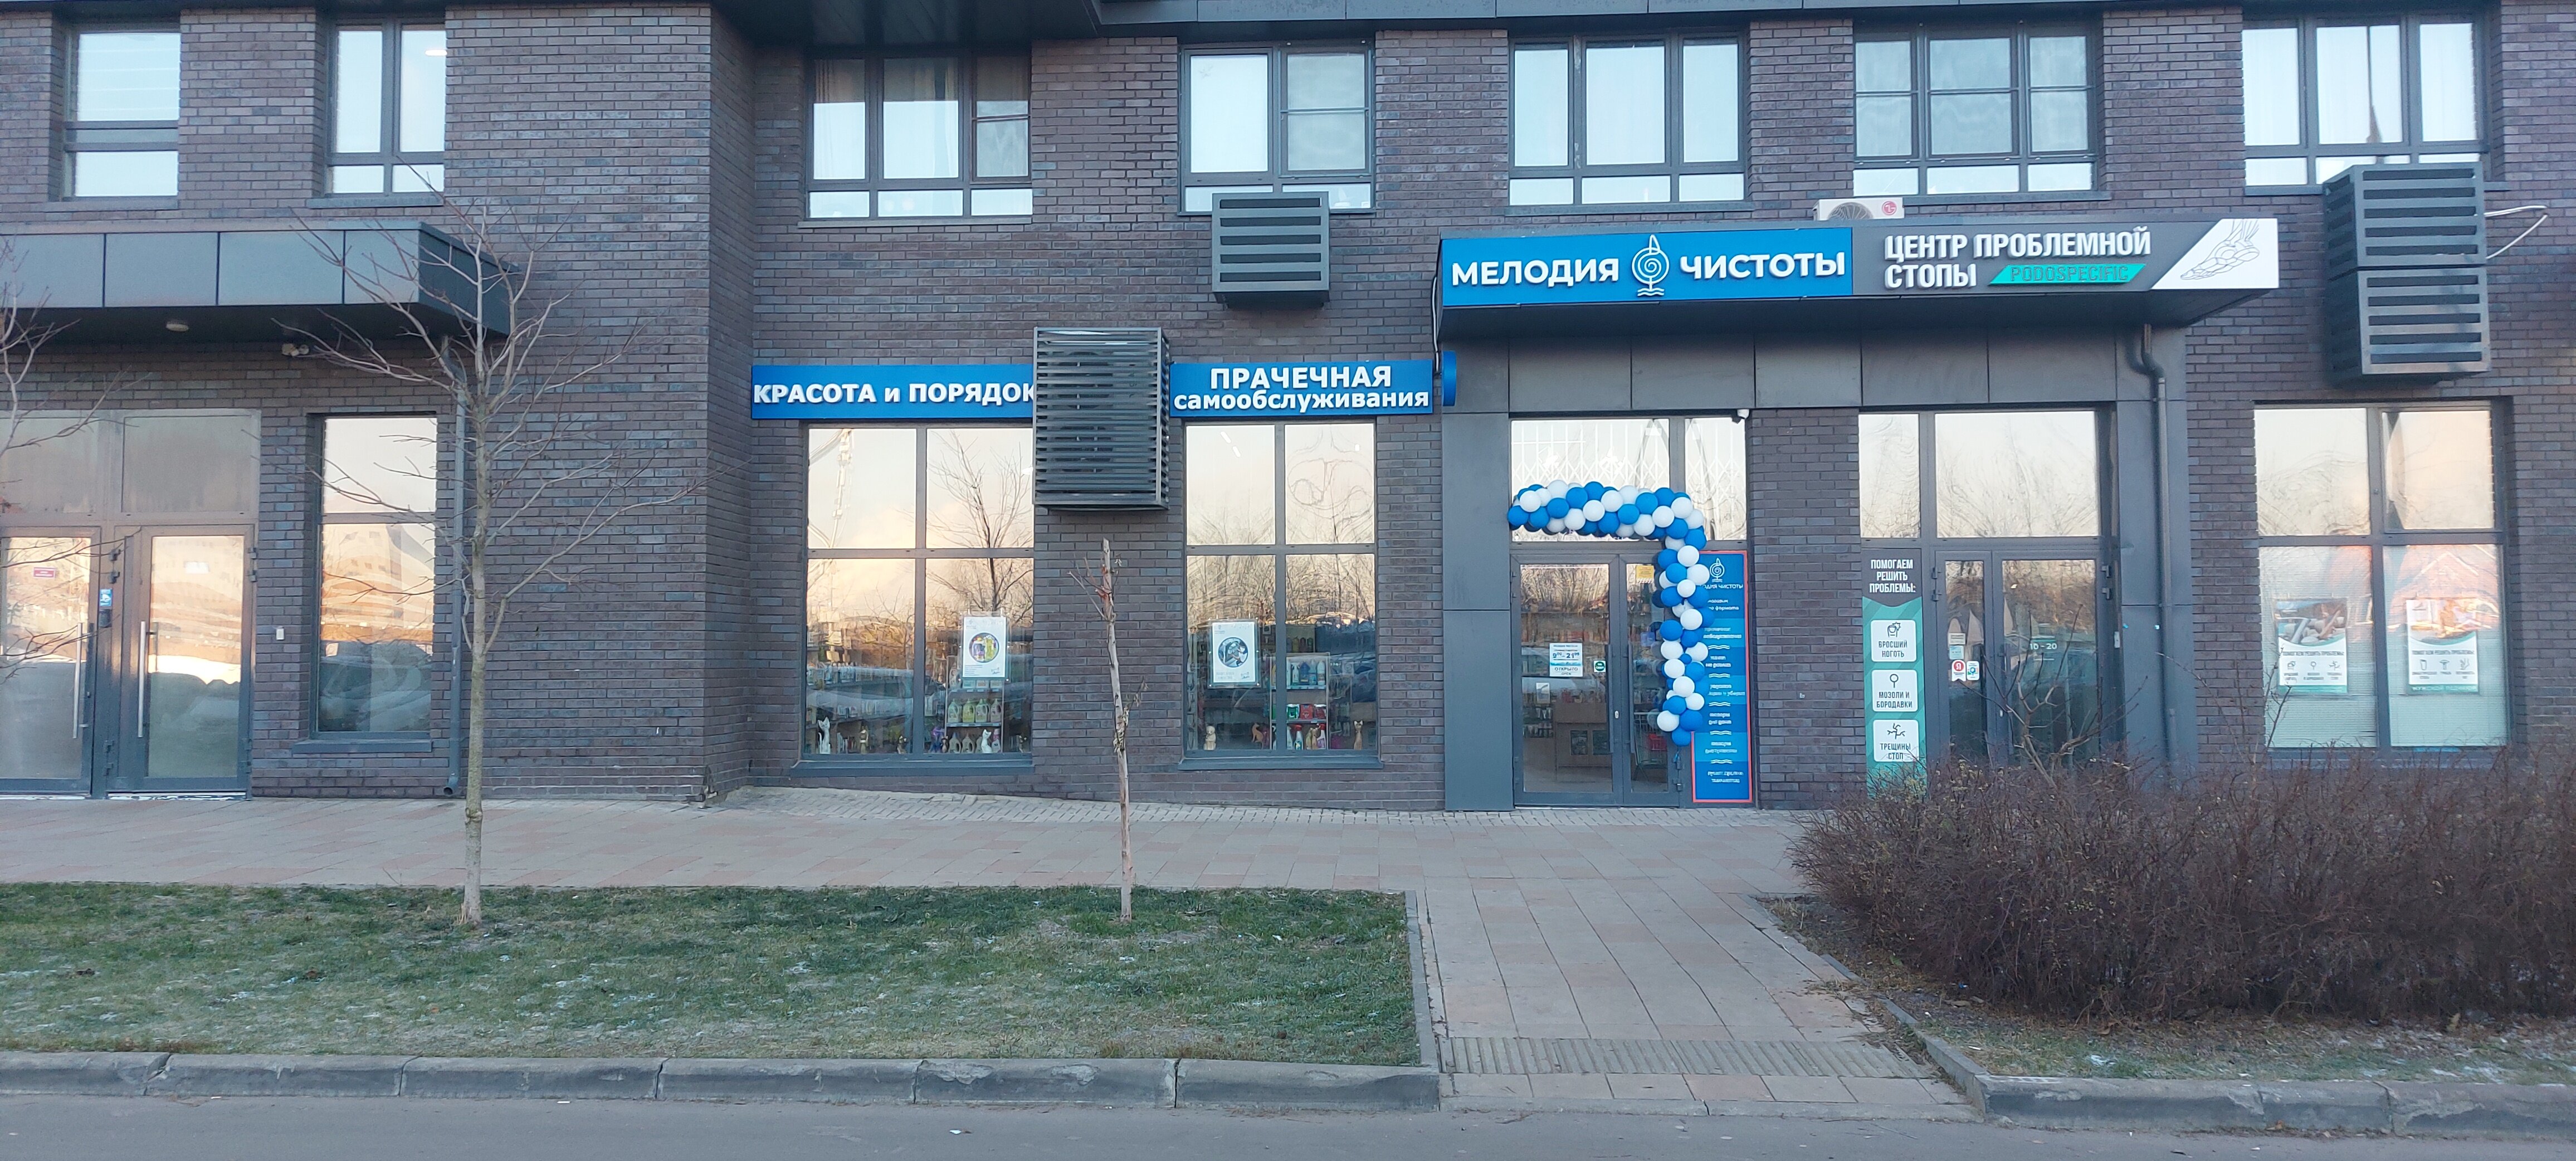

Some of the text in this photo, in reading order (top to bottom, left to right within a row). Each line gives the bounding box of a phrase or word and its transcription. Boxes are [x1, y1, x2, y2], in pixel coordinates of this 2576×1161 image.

[1885, 226, 2151, 263] ЦЕНТР ПРОБЛЕМНОЙ
[1451, 252, 1845, 287] МЕЛОДИЯ ЧИСТОТЫ
[1885, 263, 1977, 289] СТОПЫ
[2010, 266, 2128, 282] PODOSPECIFIC
[1210, 365, 1392, 389] ПРАЧЕЧНАЯ
[753, 383, 1034, 406] КРАСОТА и ПОРЯДОК
[1174, 389, 1429, 413] самообслуживания
[1870, 559, 1914, 569] ПОМОГАЕМ
[1876, 571, 1908, 581] РЕШИТЬ
[1869, 583, 1916, 593] ПРОБЛЕМЫ:
[1878, 640, 1908, 648] ВРОСШИЙ
